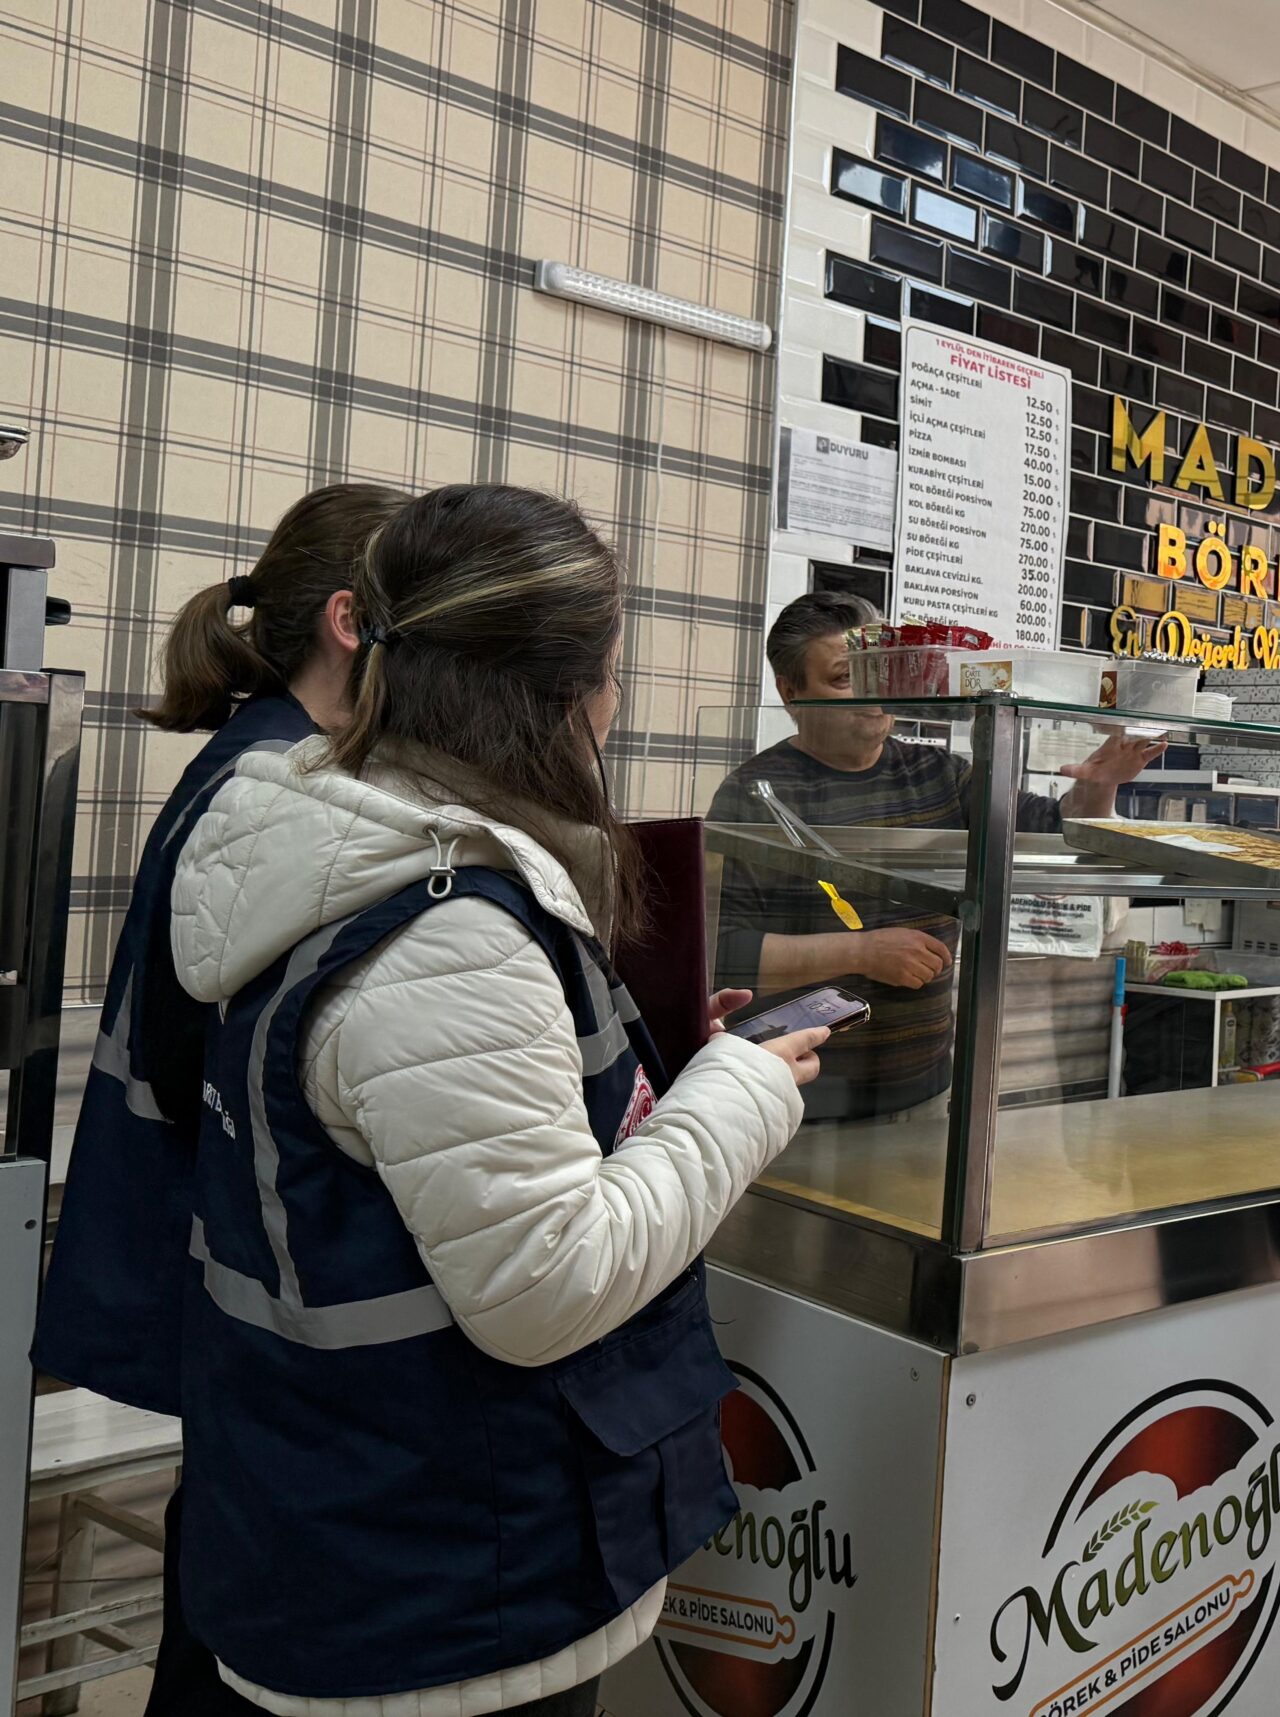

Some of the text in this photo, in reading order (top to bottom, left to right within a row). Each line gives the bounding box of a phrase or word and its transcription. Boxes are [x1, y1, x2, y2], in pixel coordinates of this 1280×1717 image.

[941, 340, 964, 354] EYLÜL
[967, 348, 981, 359] DEN
[983, 352, 1015, 370] İTİBAREN
[1017, 364, 1044, 379] GEÇERLİ
[951, 354, 1031, 389] FİYAT LİSTESİ
[911, 379, 934, 392] AÇMA
[940, 386, 960, 399] SADE
[1026, 412, 1052, 429] 12.50
[912, 362, 1052, 413] POĞAÇA ÇEŞİTLERİ 12.50
[910, 395, 932, 408] SİMİT
[1025, 426, 1051, 443] 12.50
[910, 411, 924, 423] İÇLİ
[926, 417, 948, 429] AÇMA
[950, 422, 986, 439] ÇEŞİTLERİ
[1024, 442, 1050, 458] 17.50
[830, 442, 869, 460] DUYURU
[909, 429, 932, 442] PİZZA
[1024, 457, 1052, 474] 40.00
[909, 445, 1051, 489] İZMİR BOMBASI 15.00
[908, 464, 946, 481] KURABİYE
[947, 474, 984, 489] ÇEŞİTLERİ
[1023, 490, 1053, 506] 20.00
[910, 482, 924, 492] KOL
[926, 485, 954, 499] BÖREĞİ
[956, 492, 992, 507] PORSİYON
[1023, 506, 1050, 521] 75.00
[908, 516, 918, 524] SU
[920, 518, 948, 531] BÖREĞİ
[950, 524, 986, 538] PORSİYON
[1020, 538, 1048, 552] 75.00
[909, 499, 923, 509] KOL
[926, 502, 953, 515] BÖREĞİ
[955, 510, 965, 518] KG
[1020, 521, 1050, 537] 270.00
[906, 547, 924, 558] PİDE
[926, 550, 963, 564] ÇEŞİTLERİ
[1021, 568, 1049, 583] 35.00
[907, 532, 918, 541] SU
[919, 534, 947, 548] BÖREĞİ
[949, 541, 959, 549] KG
[1018, 554, 1048, 569] 270.00
[904, 581, 939, 594] BAKLAVA
[941, 587, 979, 600] PORSİYON
[1020, 600, 1047, 613] 60.00
[905, 564, 941, 578] BAKLAVA
[943, 570, 970, 583] CEVİZLİ
[1018, 584, 1047, 599] 200.00
[904, 596, 925, 607] KURU
[927, 600, 950, 610] PASTA
[952, 603, 988, 617] ÇEŞİTLERİ
[989, 609, 998, 618] KG
[1016, 613, 1046, 627] 200.00
[1016, 629, 1045, 643] 180.00
[1110, 605, 1144, 659] En
[704, 1500, 858, 1613] enoğlu
[679, 1598, 688, 1617] &
[689, 1597, 718, 1623] PİDE
[720, 1607, 774, 1635] SALONU
[1041, 1588, 1230, 1717] ÖREK & PİDE SALONU
